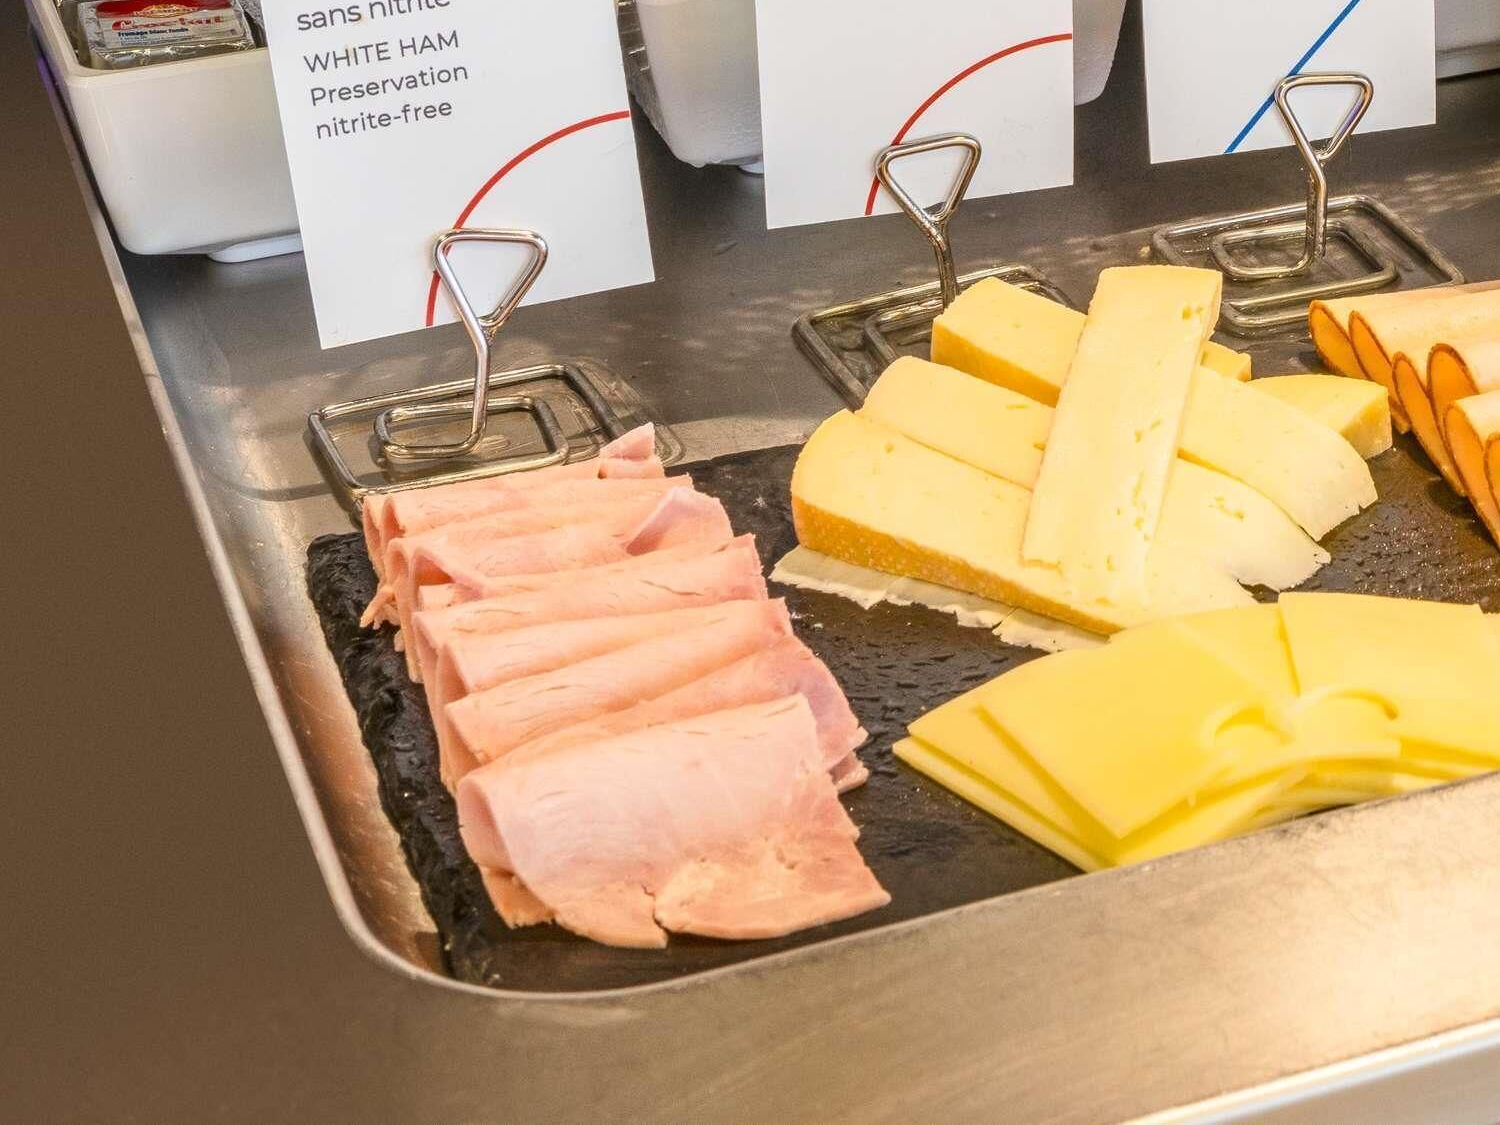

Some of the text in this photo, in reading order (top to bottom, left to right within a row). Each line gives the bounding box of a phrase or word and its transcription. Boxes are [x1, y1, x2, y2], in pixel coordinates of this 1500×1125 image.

[297, 3, 362, 31] sans
[303, 31, 460, 74] WHITE HAM
[311, 64, 468, 106] Preservation
[316, 101, 453, 139] nitrite-free
